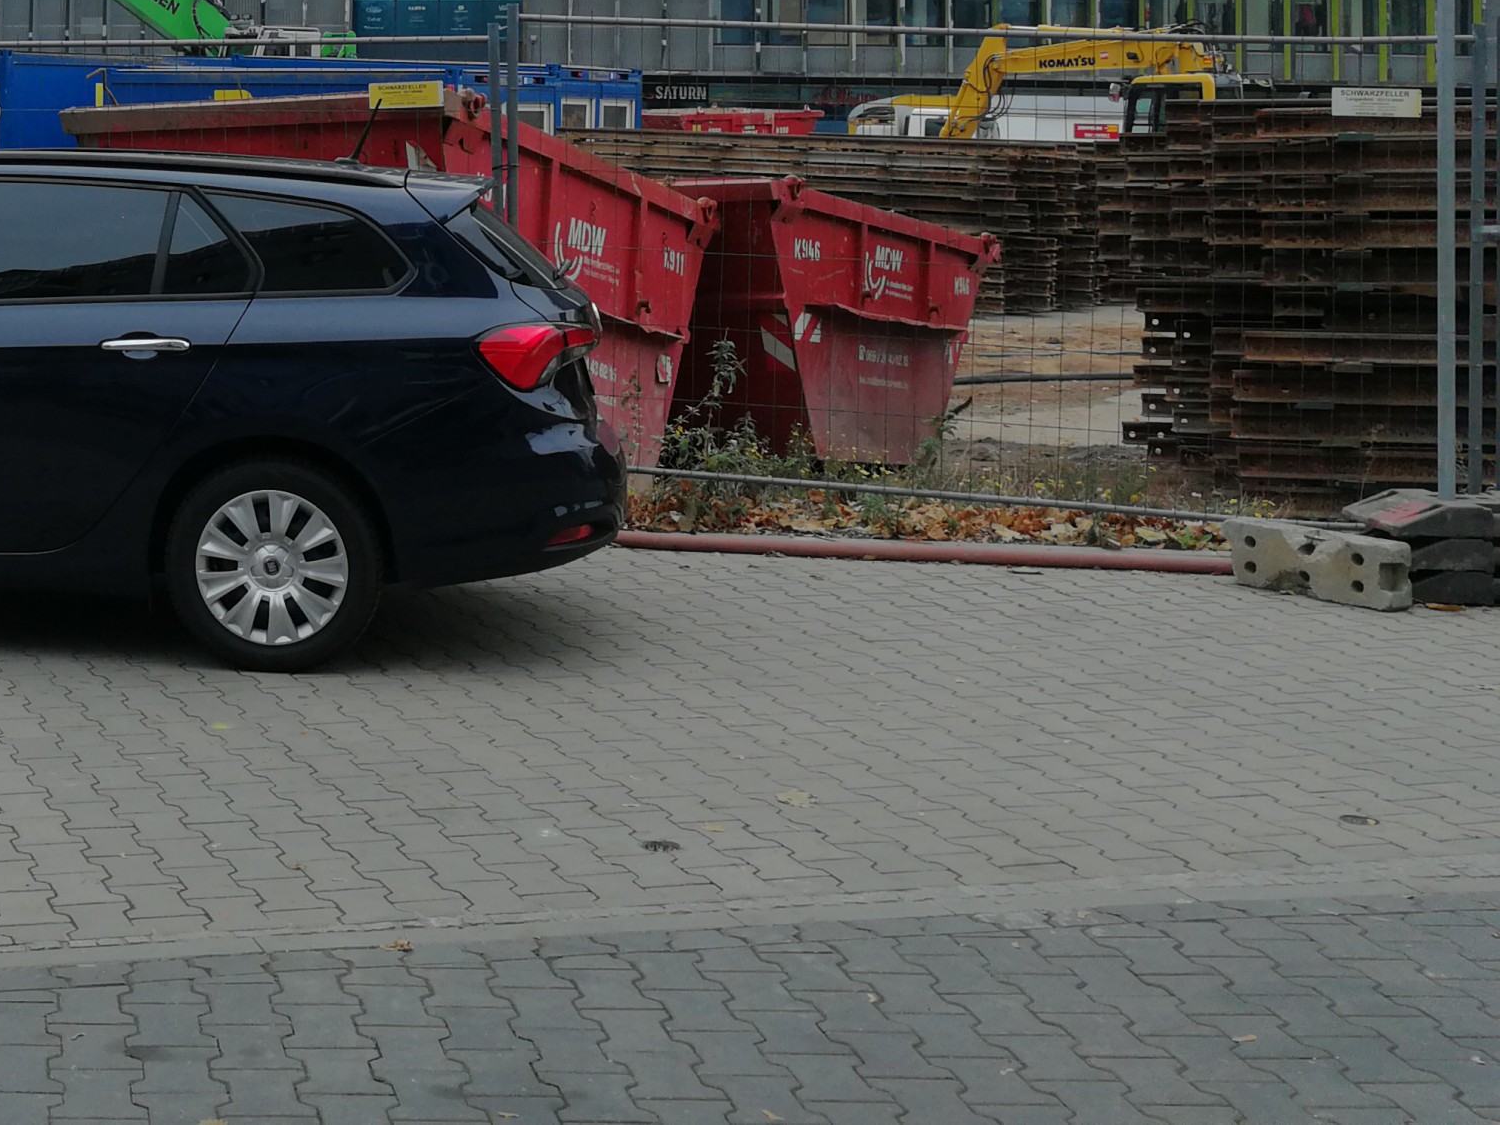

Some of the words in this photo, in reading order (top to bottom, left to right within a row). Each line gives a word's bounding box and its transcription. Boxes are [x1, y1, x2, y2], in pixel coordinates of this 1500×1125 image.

[1038, 55, 1096, 69] KOMATSU
[655, 85, 707, 100] SATURN
[1340, 89, 1410, 97] SCHWARZFELLER
[567, 217, 606, 257] MDW
[794, 238, 821, 262] K946
[874, 245, 904, 274] MDW
